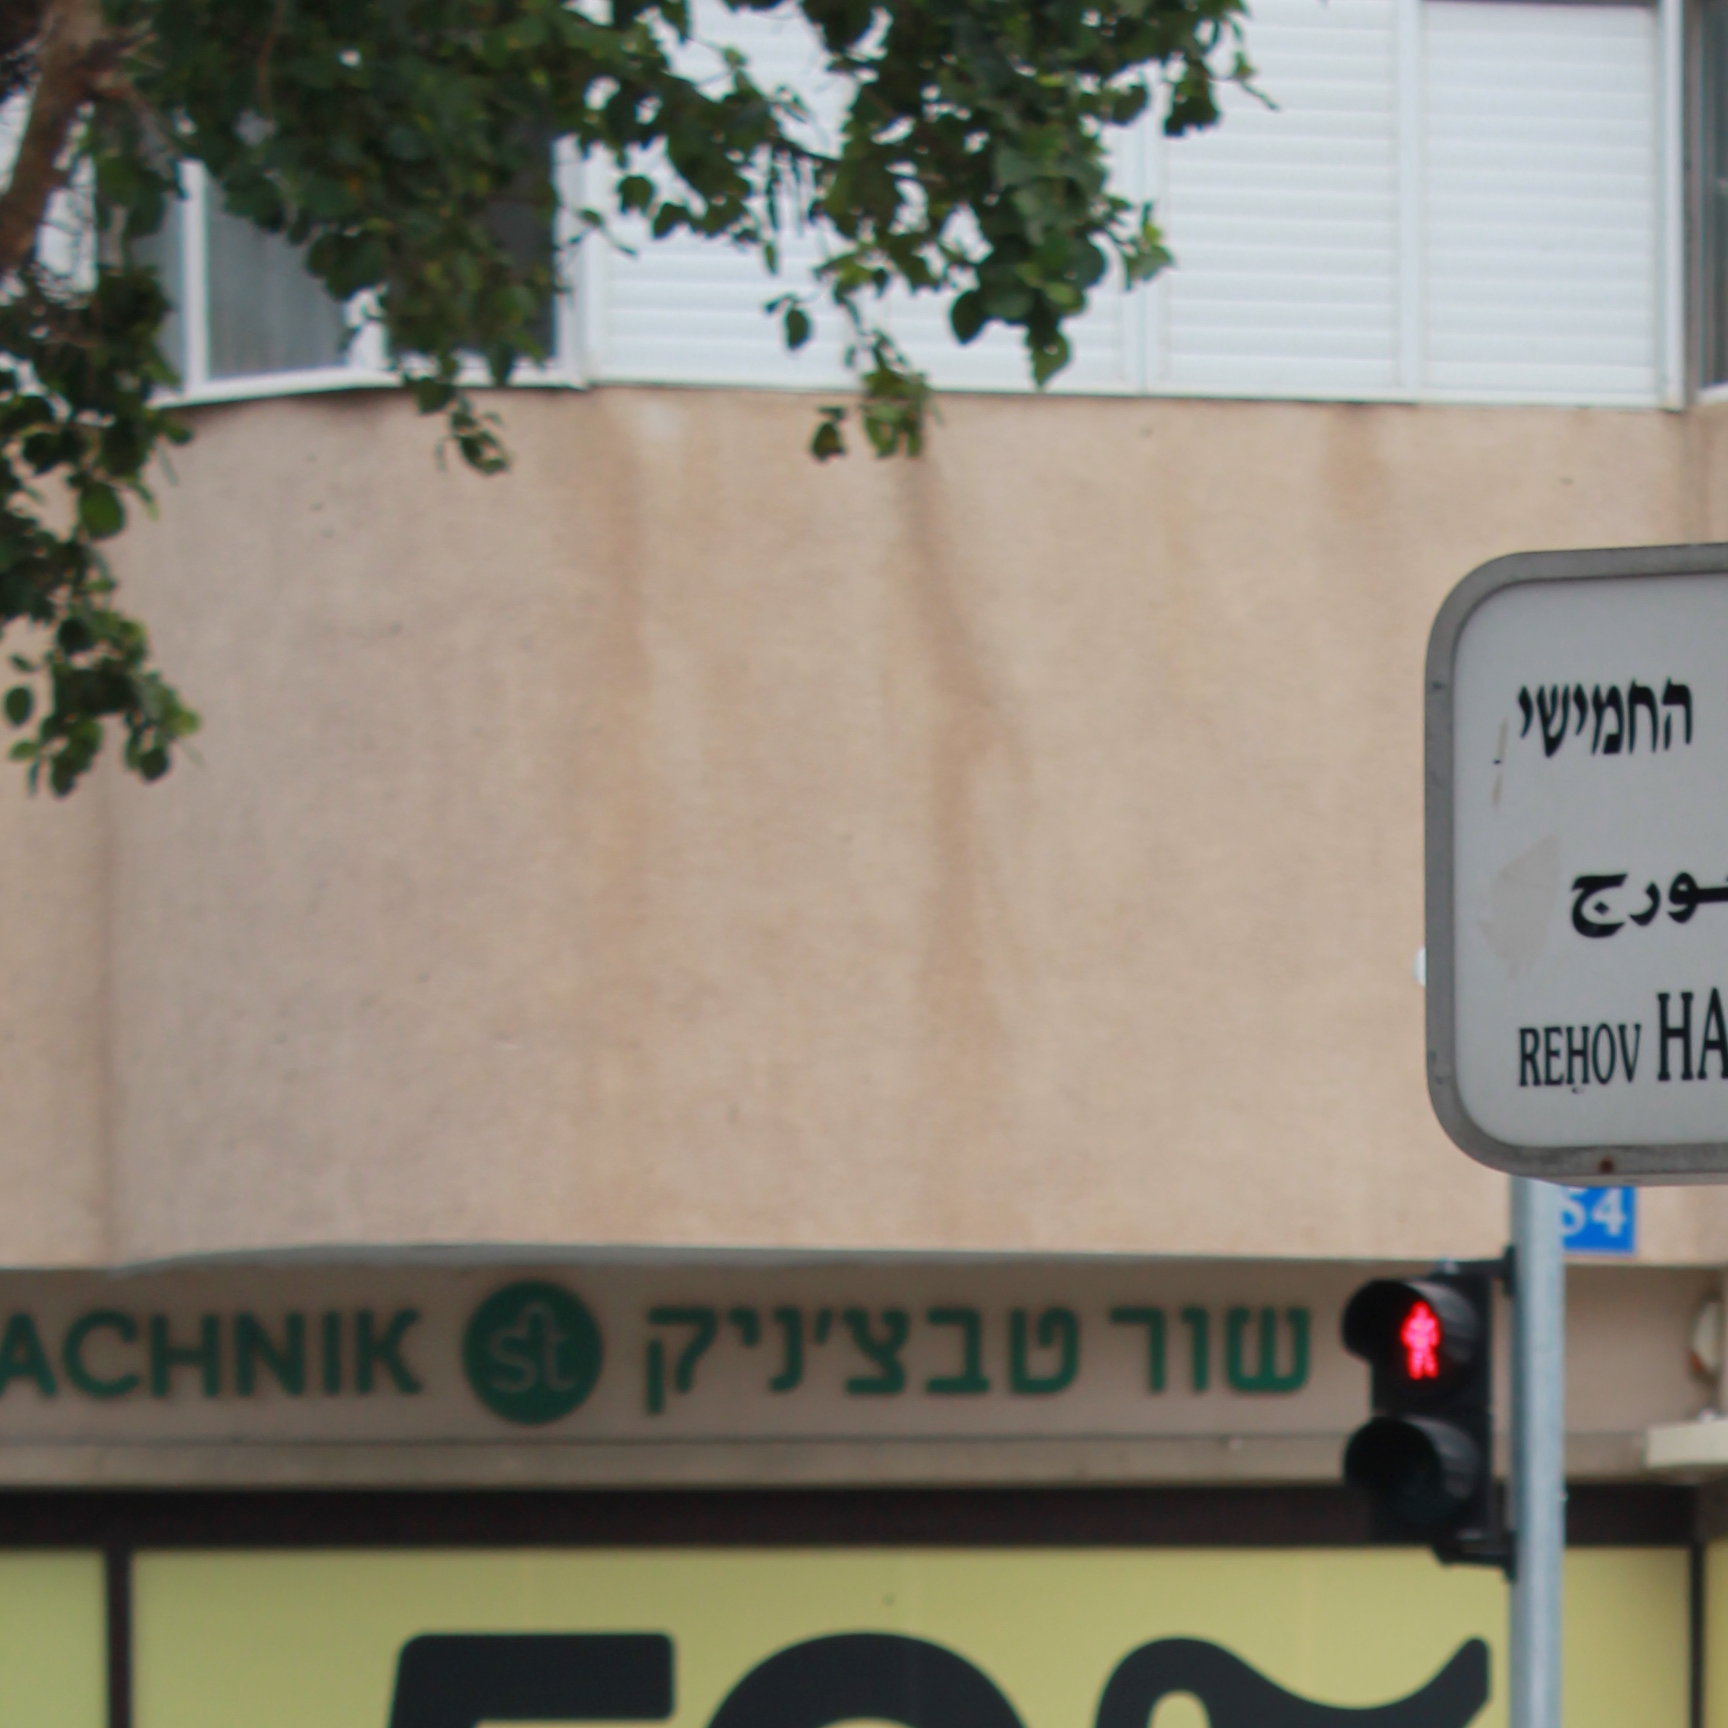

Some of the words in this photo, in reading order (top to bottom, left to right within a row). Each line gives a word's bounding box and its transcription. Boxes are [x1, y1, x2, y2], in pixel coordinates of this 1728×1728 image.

[1517, 677, 1694, 758] החמישי
[1517, 1022, 1642, 1089] REHOV
[646, 1306, 1081, 1416] טבצ'ניק
[1107, 1306, 1311, 1394] שור
